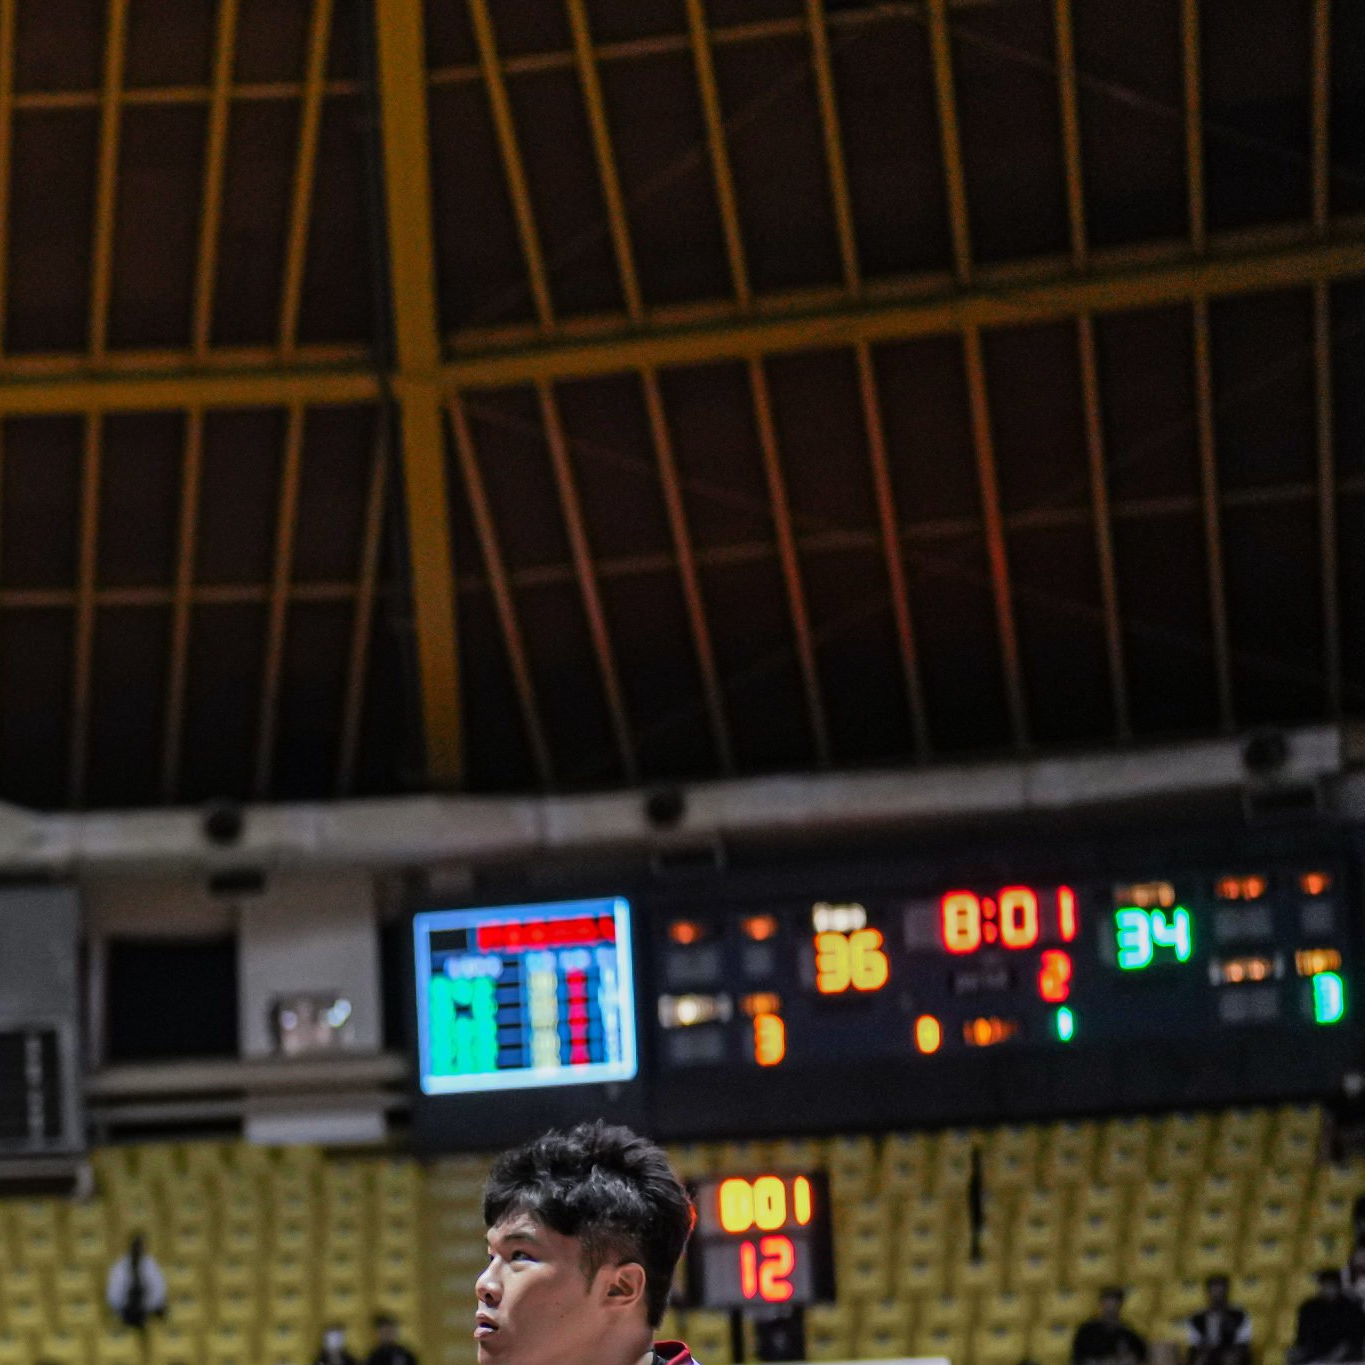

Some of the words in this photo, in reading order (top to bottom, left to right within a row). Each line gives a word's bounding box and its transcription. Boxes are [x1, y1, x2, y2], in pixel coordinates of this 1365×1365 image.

[939, 884, 1077, 954] 8:01
[1116, 907, 1191, 970] 34
[814, 928, 888, 994] 36
[1038, 949, 1072, 1003] 2
[740, 1234, 795, 1302] 12
